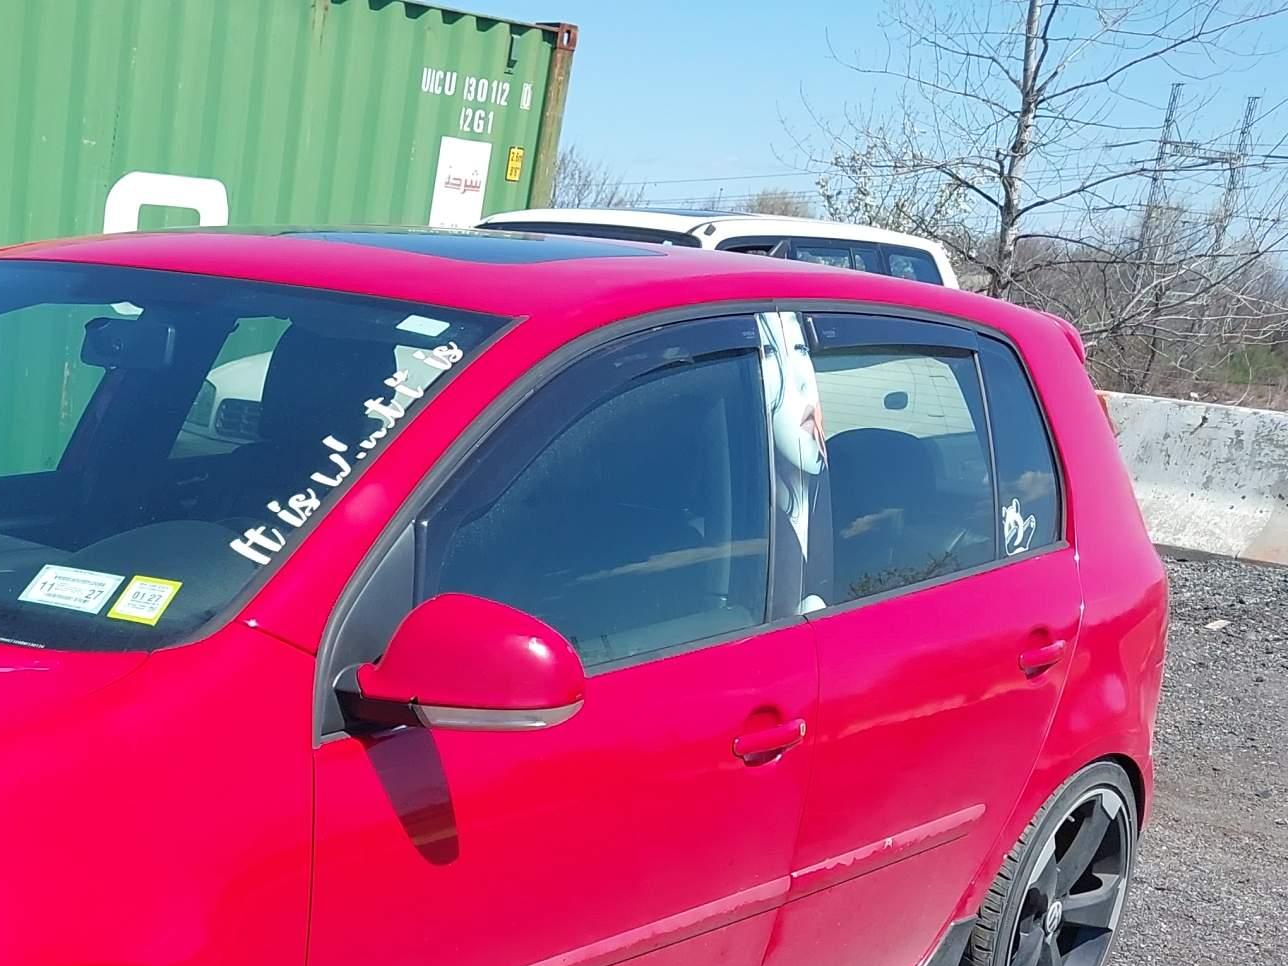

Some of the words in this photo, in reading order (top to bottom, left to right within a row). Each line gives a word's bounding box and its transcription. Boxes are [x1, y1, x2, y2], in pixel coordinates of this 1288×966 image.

[229, 525, 286, 566] It
[267, 487, 321, 528] is
[39, 580, 55, 593] 11
[84, 590, 105, 601] 27
